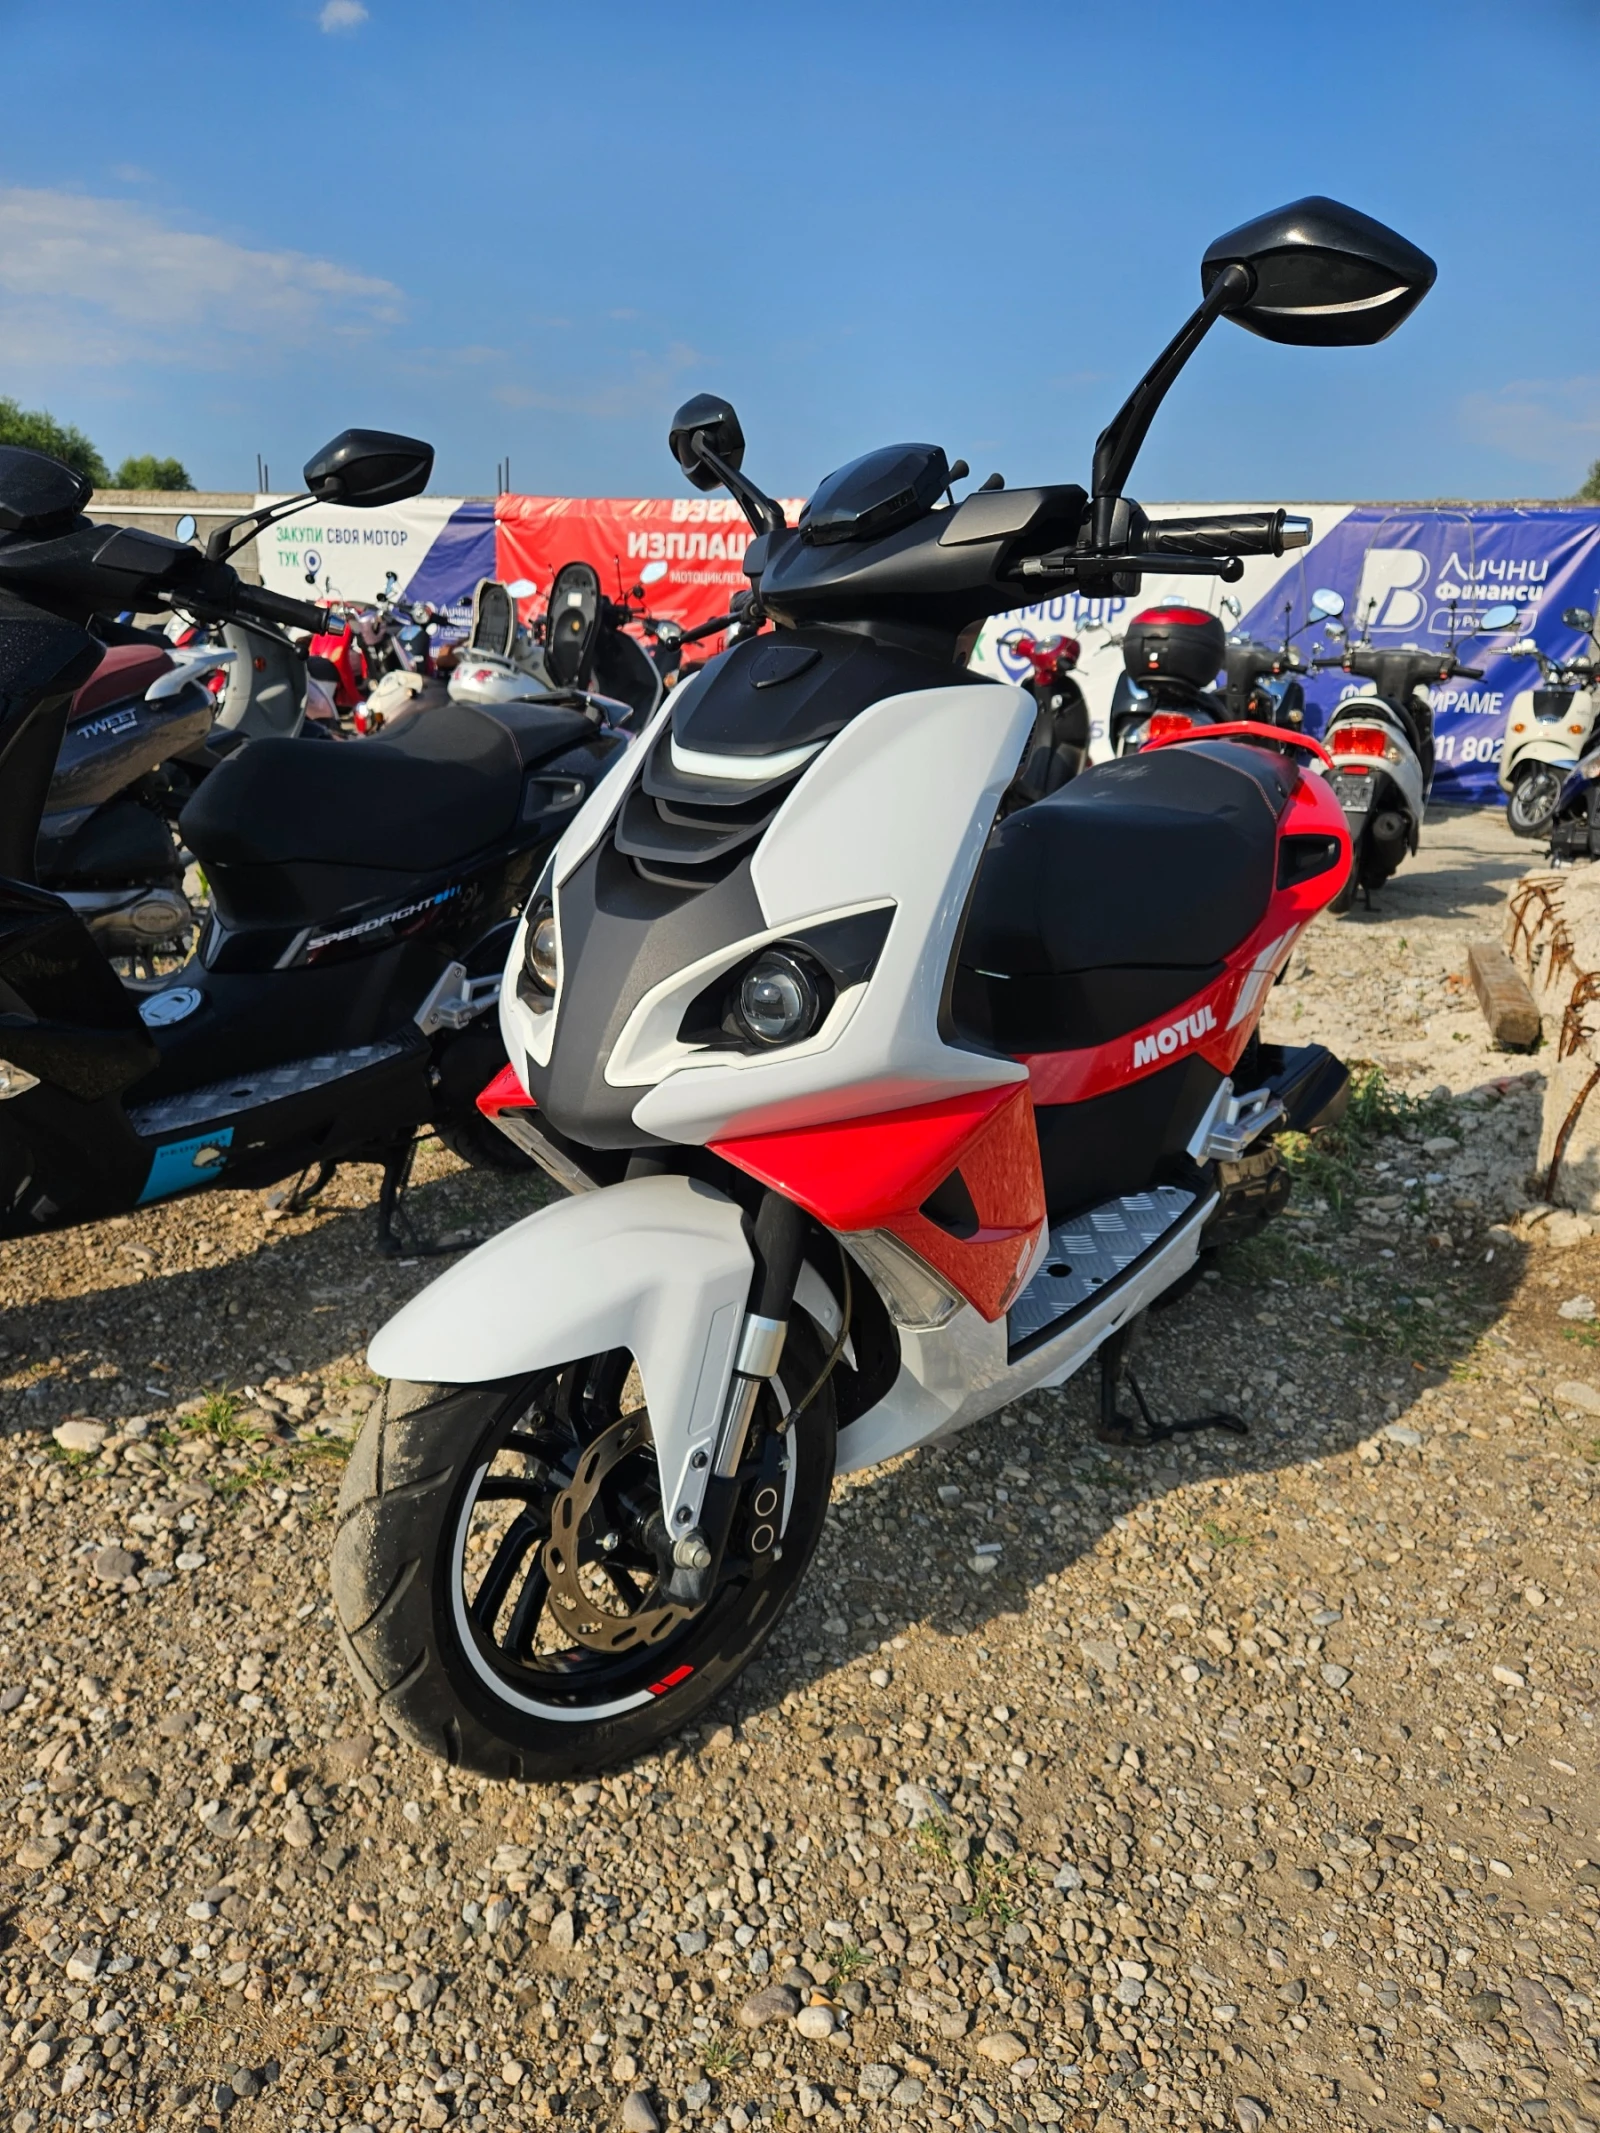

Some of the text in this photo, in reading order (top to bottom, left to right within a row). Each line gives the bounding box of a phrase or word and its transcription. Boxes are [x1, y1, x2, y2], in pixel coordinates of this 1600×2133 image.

[276, 526, 408, 546] ЗАКУПИ СВОЯ МОТОР
[278, 551, 300, 567] ТУК
[306, 897, 434, 951] SPEEDFIGHT
[1133, 1004, 1217, 1069] MOTUL
